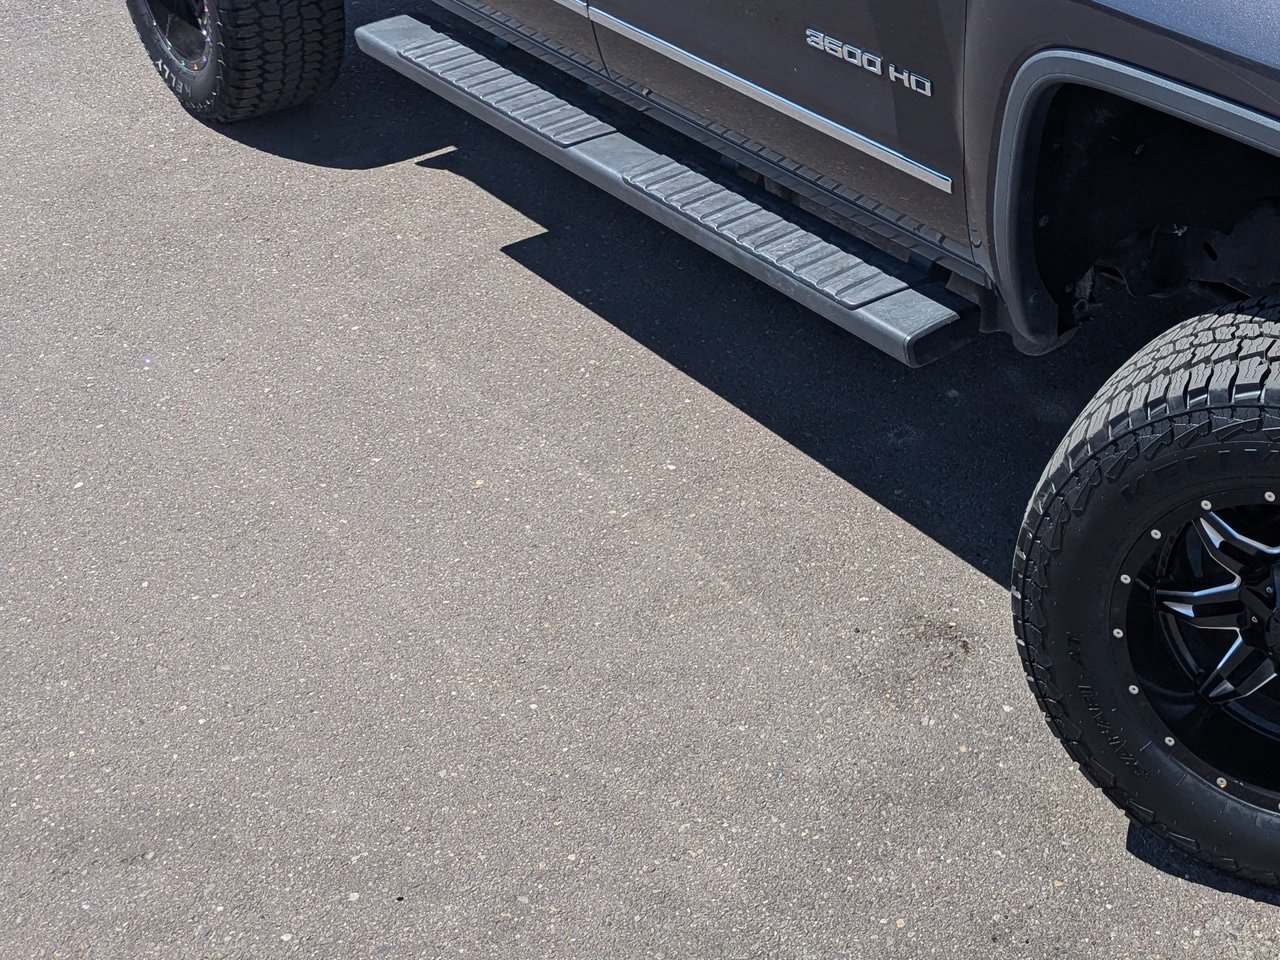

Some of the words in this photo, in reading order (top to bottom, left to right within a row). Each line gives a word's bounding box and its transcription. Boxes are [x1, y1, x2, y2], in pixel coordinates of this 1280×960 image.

[154, 58, 192, 98] KELLY
[805, 28, 883, 76] 3500
[888, 63, 932, 97] HD
